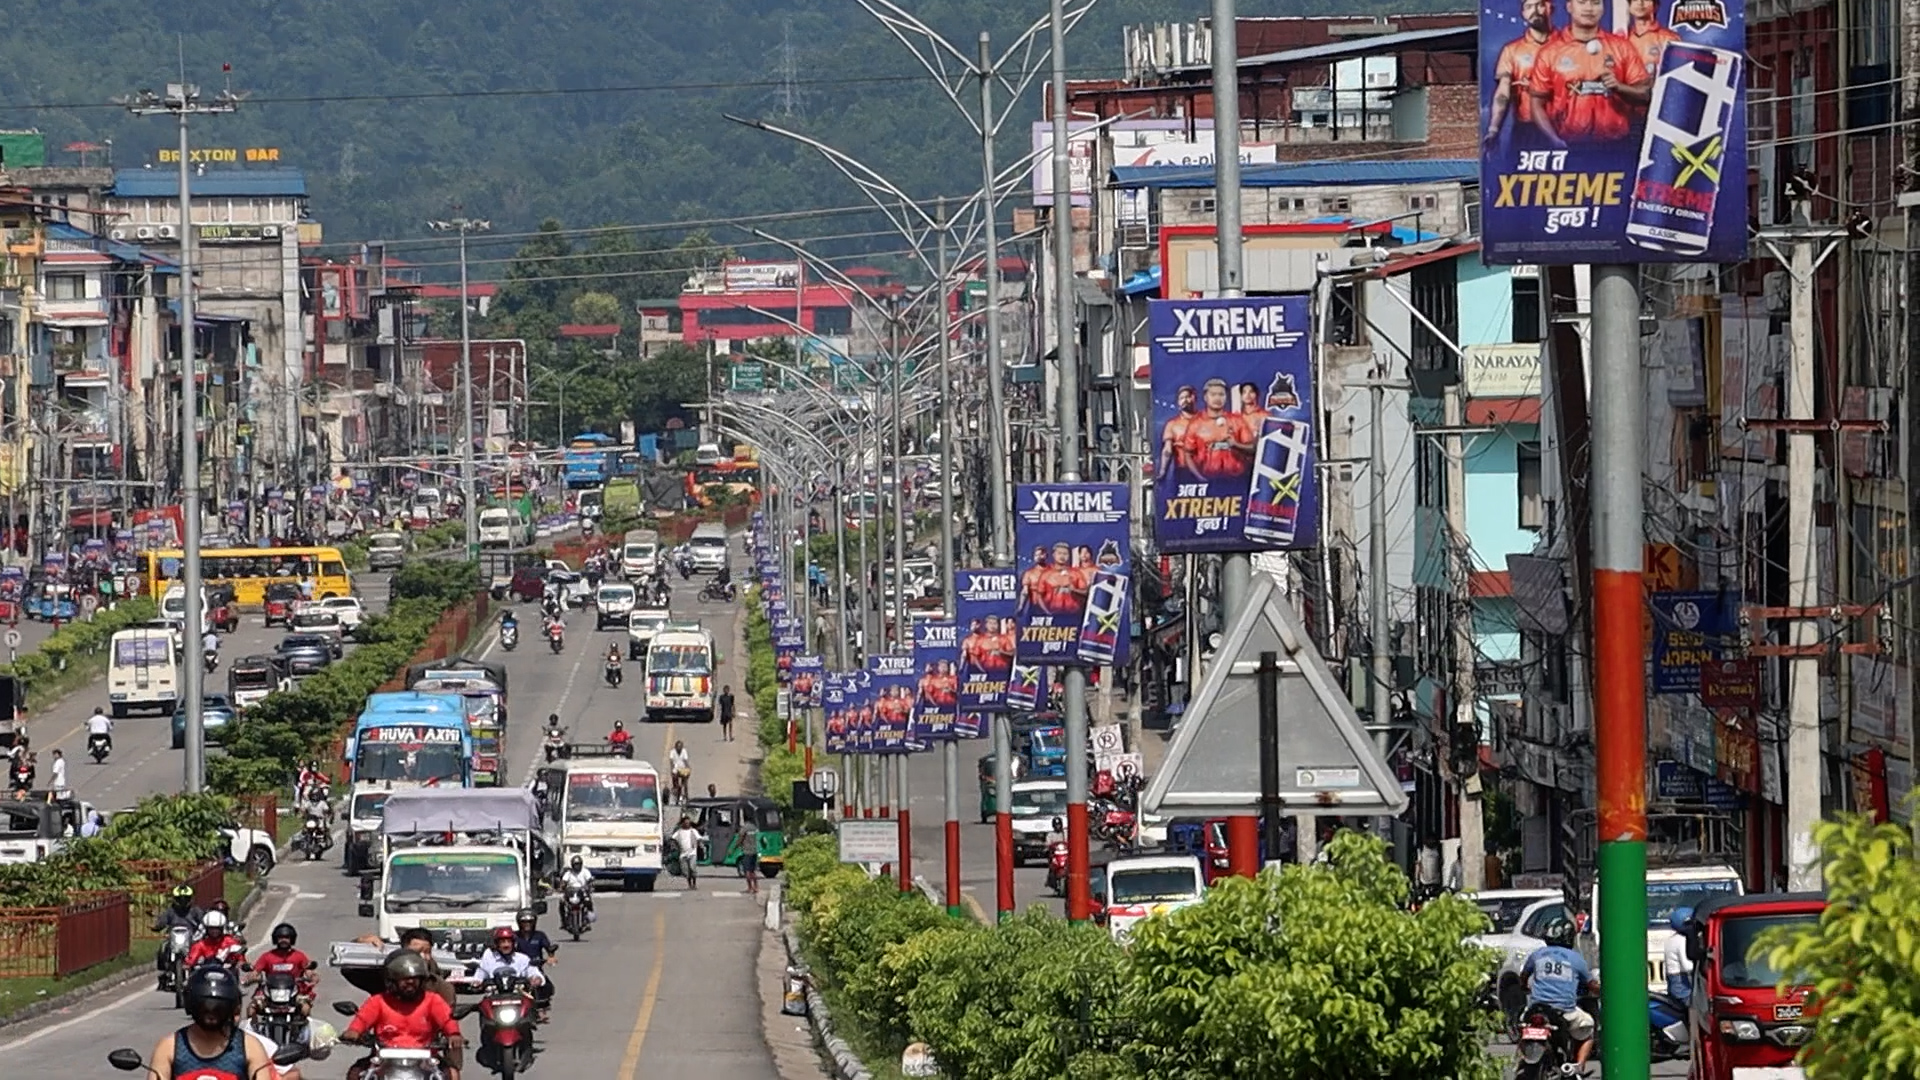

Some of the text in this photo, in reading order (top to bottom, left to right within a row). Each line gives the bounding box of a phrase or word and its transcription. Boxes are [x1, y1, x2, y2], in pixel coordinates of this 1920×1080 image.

[159, 148, 279, 162] BRXTON BAR
[1494, 171, 1625, 208] XTREME
[1173, 305, 1286, 337] XTREME
[1184, 334, 1276, 353] ENERGY DRINK
[1032, 491, 1113, 512] XTREME
[1164, 496, 1242, 520] XTREME
[1020, 626, 1078, 643] XTREME
[962, 681, 1007, 696] XTREME
[1545, 961, 1563, 975] 98
